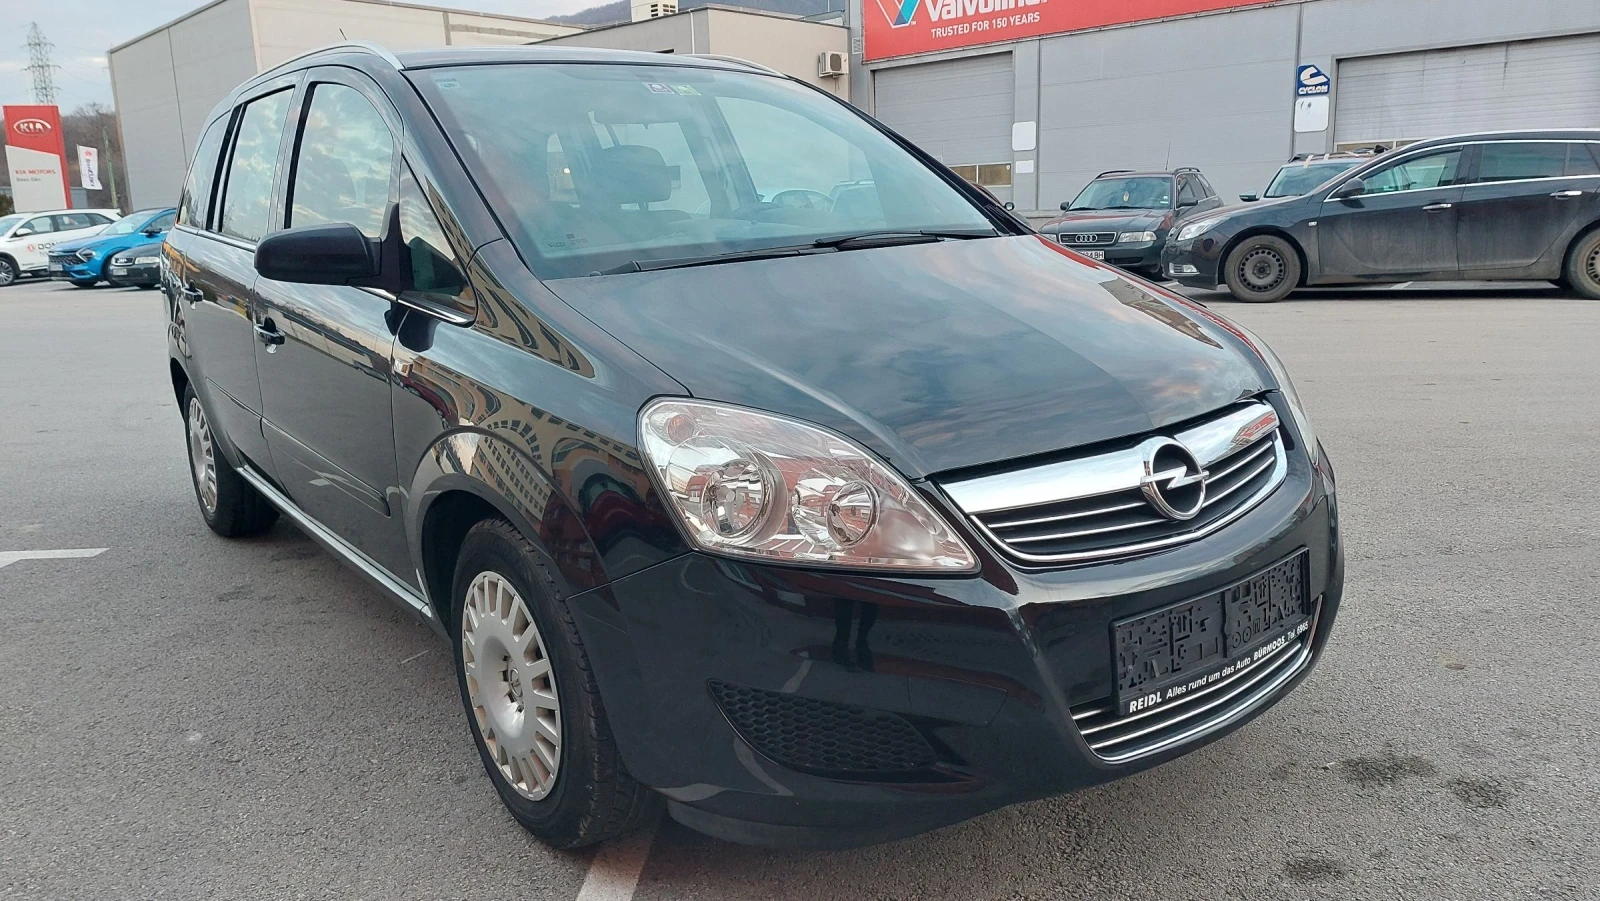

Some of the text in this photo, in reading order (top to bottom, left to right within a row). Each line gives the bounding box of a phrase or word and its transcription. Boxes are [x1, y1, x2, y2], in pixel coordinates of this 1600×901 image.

[931, 23, 970, 38] TRUSTED
[971, 20, 989, 32] FOR
[992, 17, 1008, 29] 150
[1009, 12, 1040, 26] YEARS
[1298, 85, 1328, 94] CYCLON
[20, 122, 44, 133] KIA
[1129, 691, 1162, 713] REIDL
[1166, 684, 1187, 700] Alles
[1188, 674, 1207, 691] rund
[1208, 670, 1221, 683] um
[1222, 665, 1235, 677] das
[1235, 656, 1251, 671] Auto
